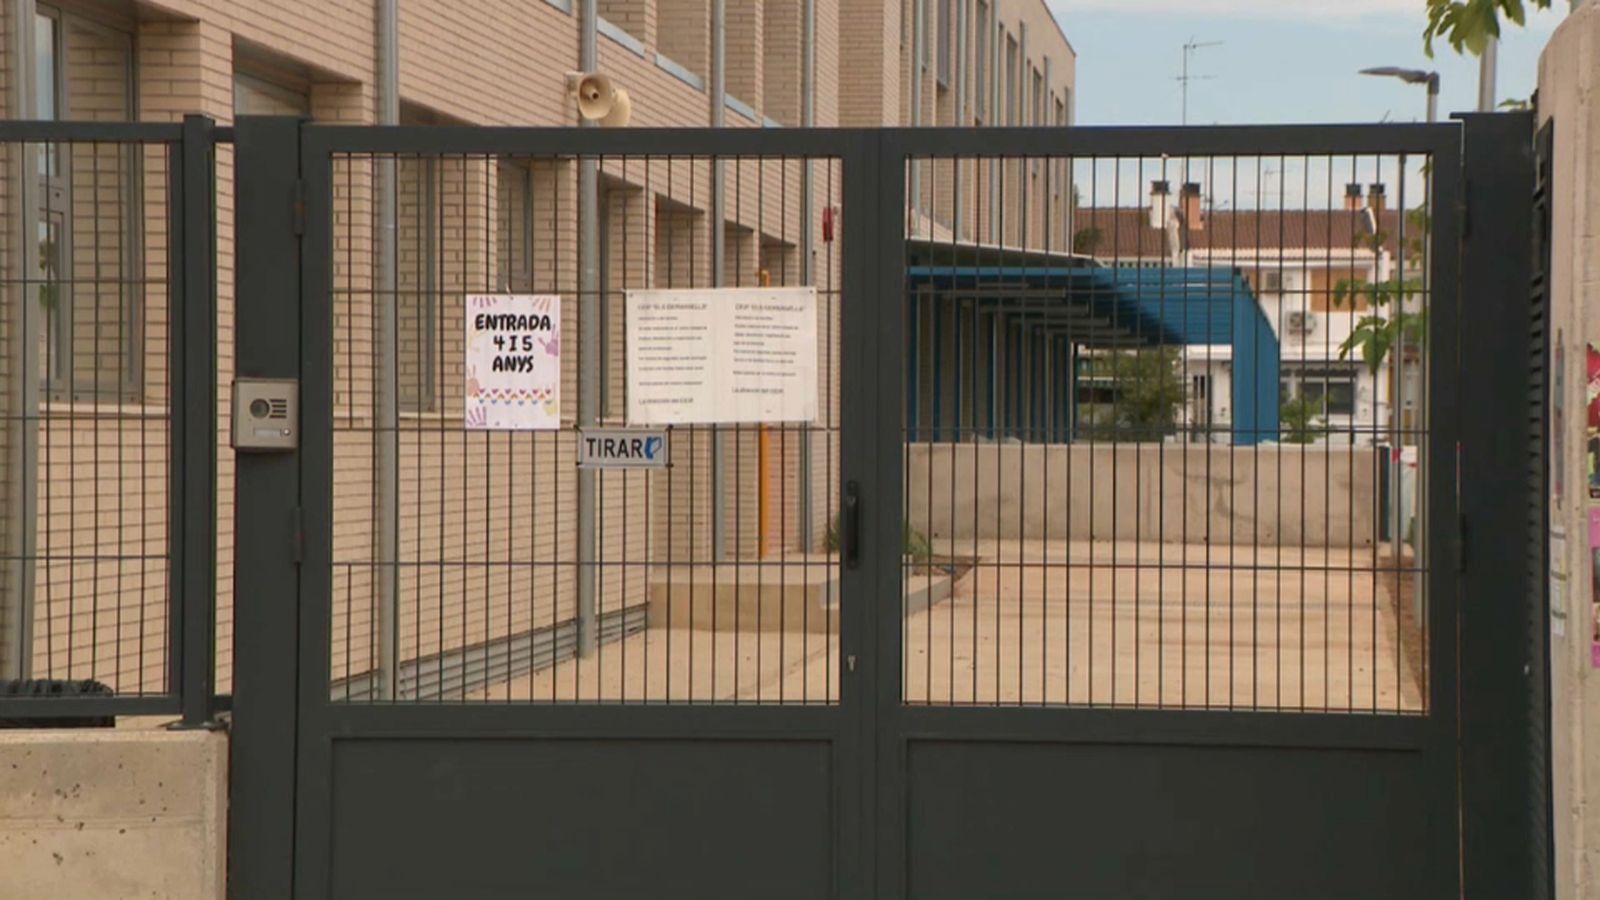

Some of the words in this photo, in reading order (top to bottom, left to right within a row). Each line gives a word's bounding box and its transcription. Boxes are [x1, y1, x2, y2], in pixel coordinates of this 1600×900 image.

[475, 314, 551, 331] ENTRADA
[493, 335, 505, 351] 4
[509, 335, 518, 352] I
[522, 335, 533, 352] 5
[492, 355, 534, 373] ANYS
[586, 438, 643, 458] TIRAR
